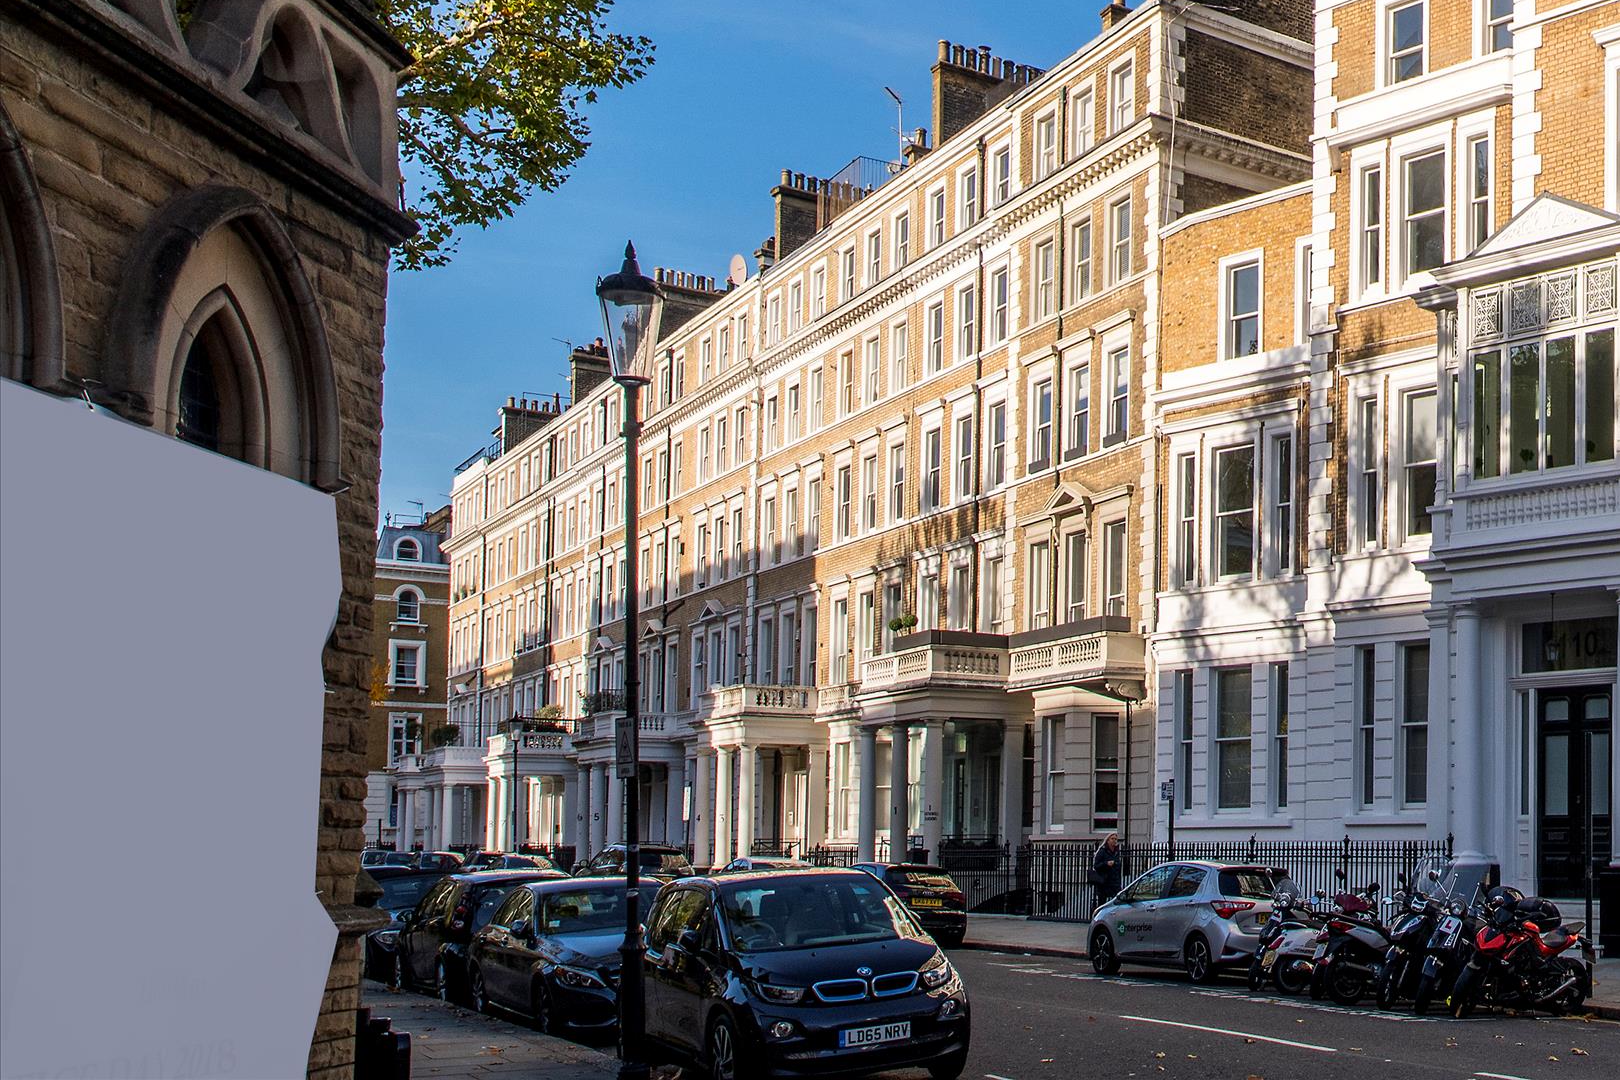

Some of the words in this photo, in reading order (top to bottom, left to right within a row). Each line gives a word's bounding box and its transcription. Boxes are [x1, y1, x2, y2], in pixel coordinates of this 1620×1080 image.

[594, 813, 600, 821] 5
[1445, 919, 1452, 929] L
[848, 1028, 882, 1044] LD65
[885, 1023, 909, 1039] NRV
